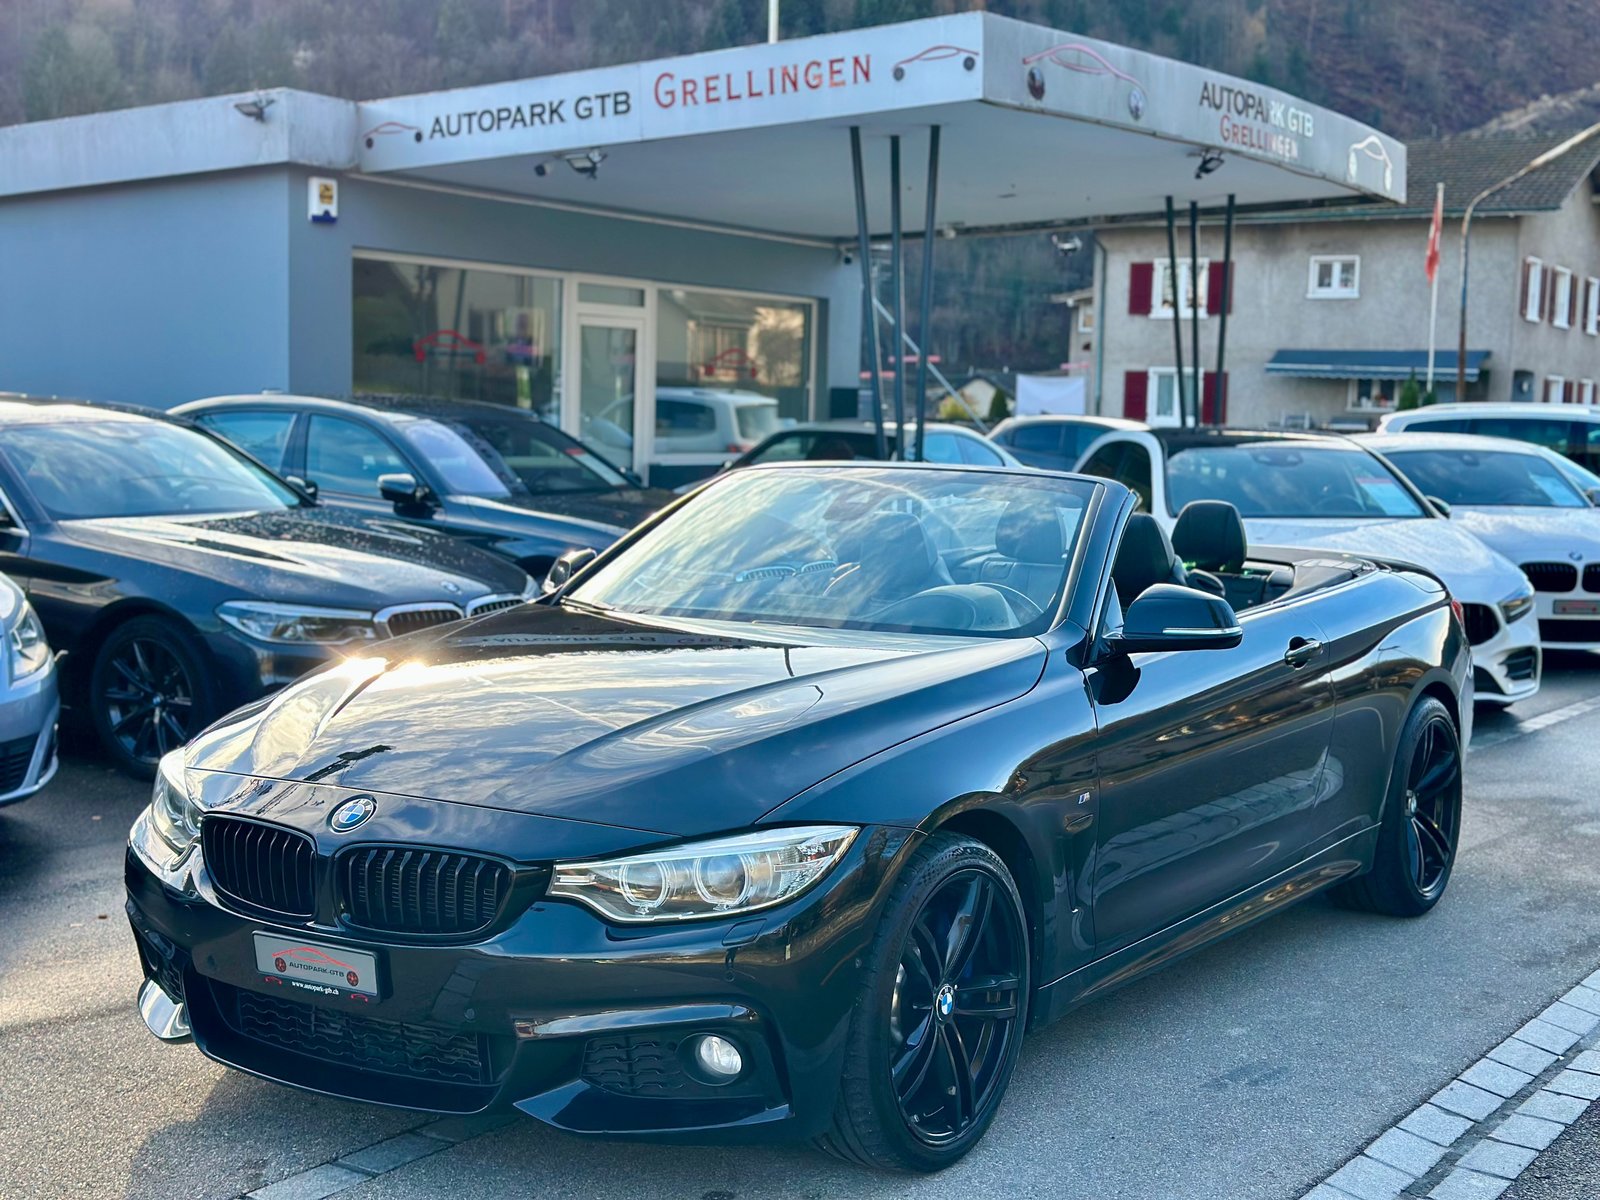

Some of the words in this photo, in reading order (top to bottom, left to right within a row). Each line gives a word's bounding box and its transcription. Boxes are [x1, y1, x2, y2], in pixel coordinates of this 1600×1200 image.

[429, 98, 565, 139] AUTOPARK
[574, 91, 631, 120] GTB
[654, 54, 871, 109] GRELLINGEN
[1199, 81, 1285, 129] AUTOPARK
[1287, 106, 1314, 138] GTB
